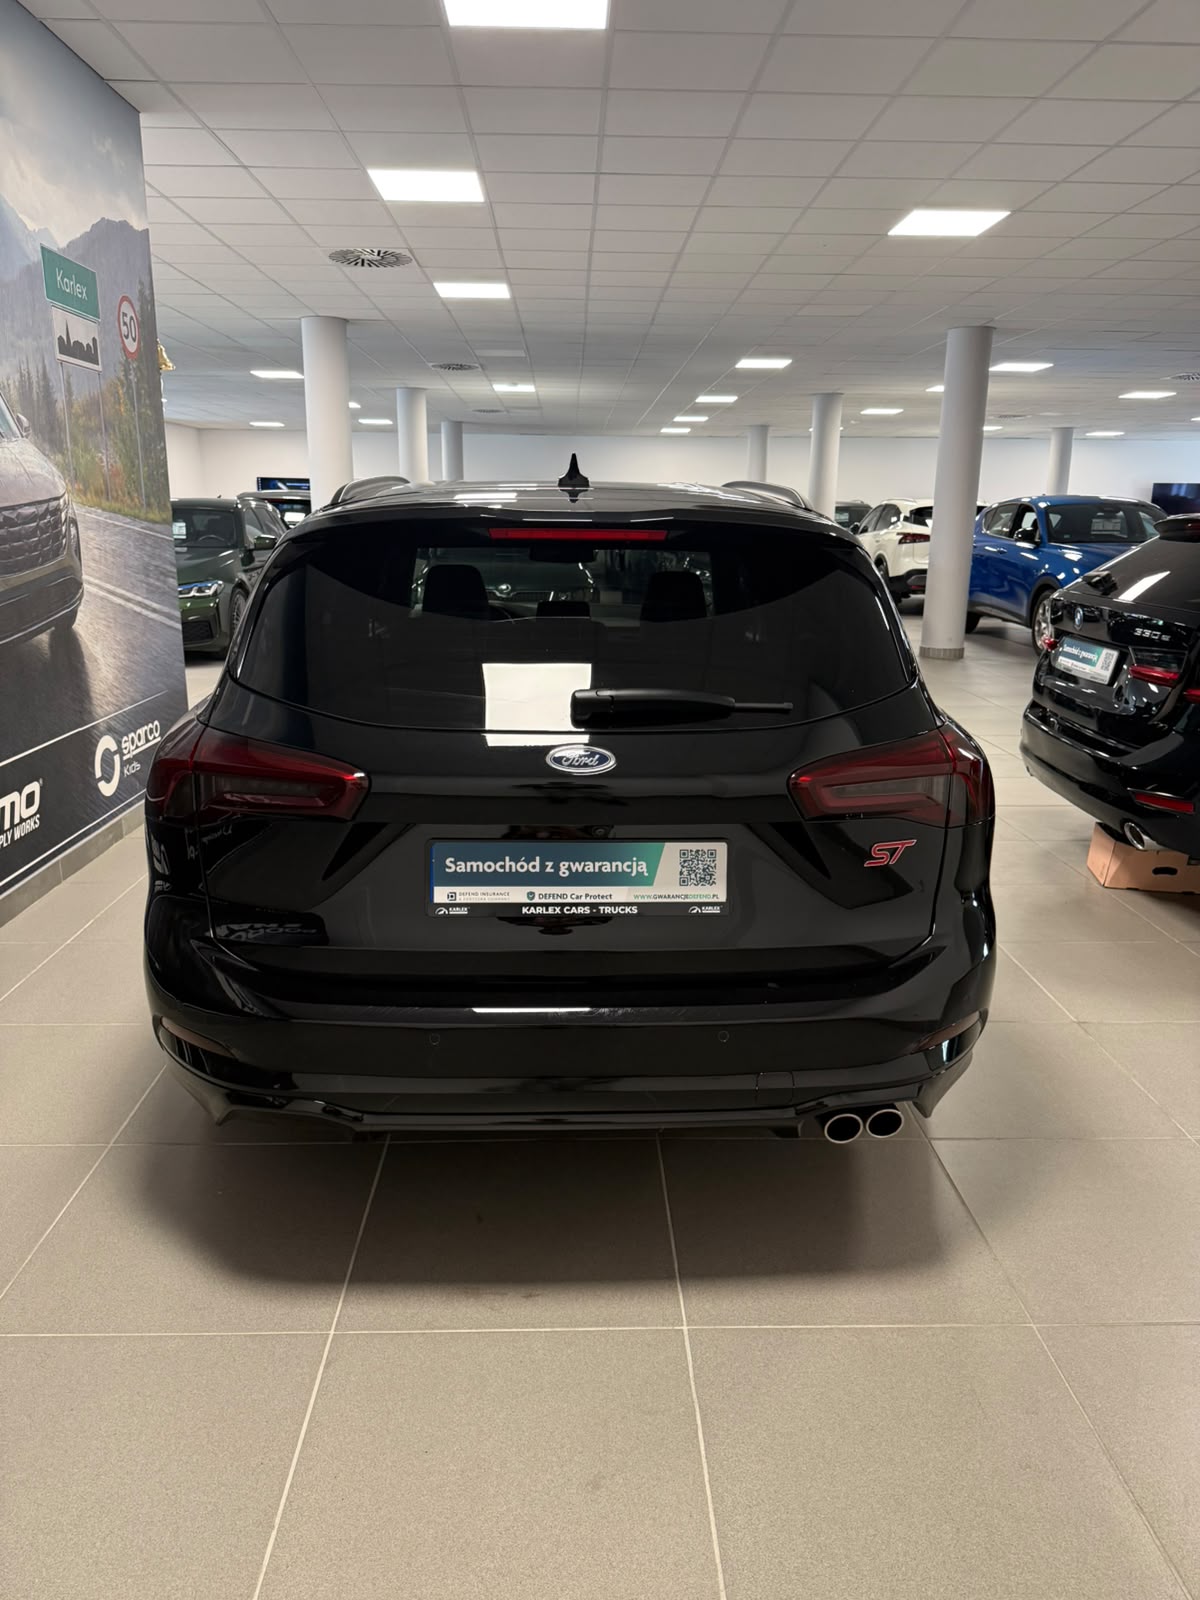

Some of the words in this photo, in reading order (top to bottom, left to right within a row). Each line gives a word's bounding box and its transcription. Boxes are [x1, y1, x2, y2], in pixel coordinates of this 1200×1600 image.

[56, 267, 88, 300] Karlex
[121, 311, 137, 343] 50
[121, 720, 161, 757] sparco
[123, 761, 141, 777] Kids
[561, 752, 600, 766] Ford
[14, 814, 41, 841] WORKS
[445, 856, 540, 873] Samochód
[545, 861, 554, 873] z
[559, 857, 648, 877] gwarancją
[863, 839, 917, 867] ST
[522, 906, 561, 914] KARLEX
[564, 906, 590, 914] CARS
[599, 906, 638, 914] TRUCKS
